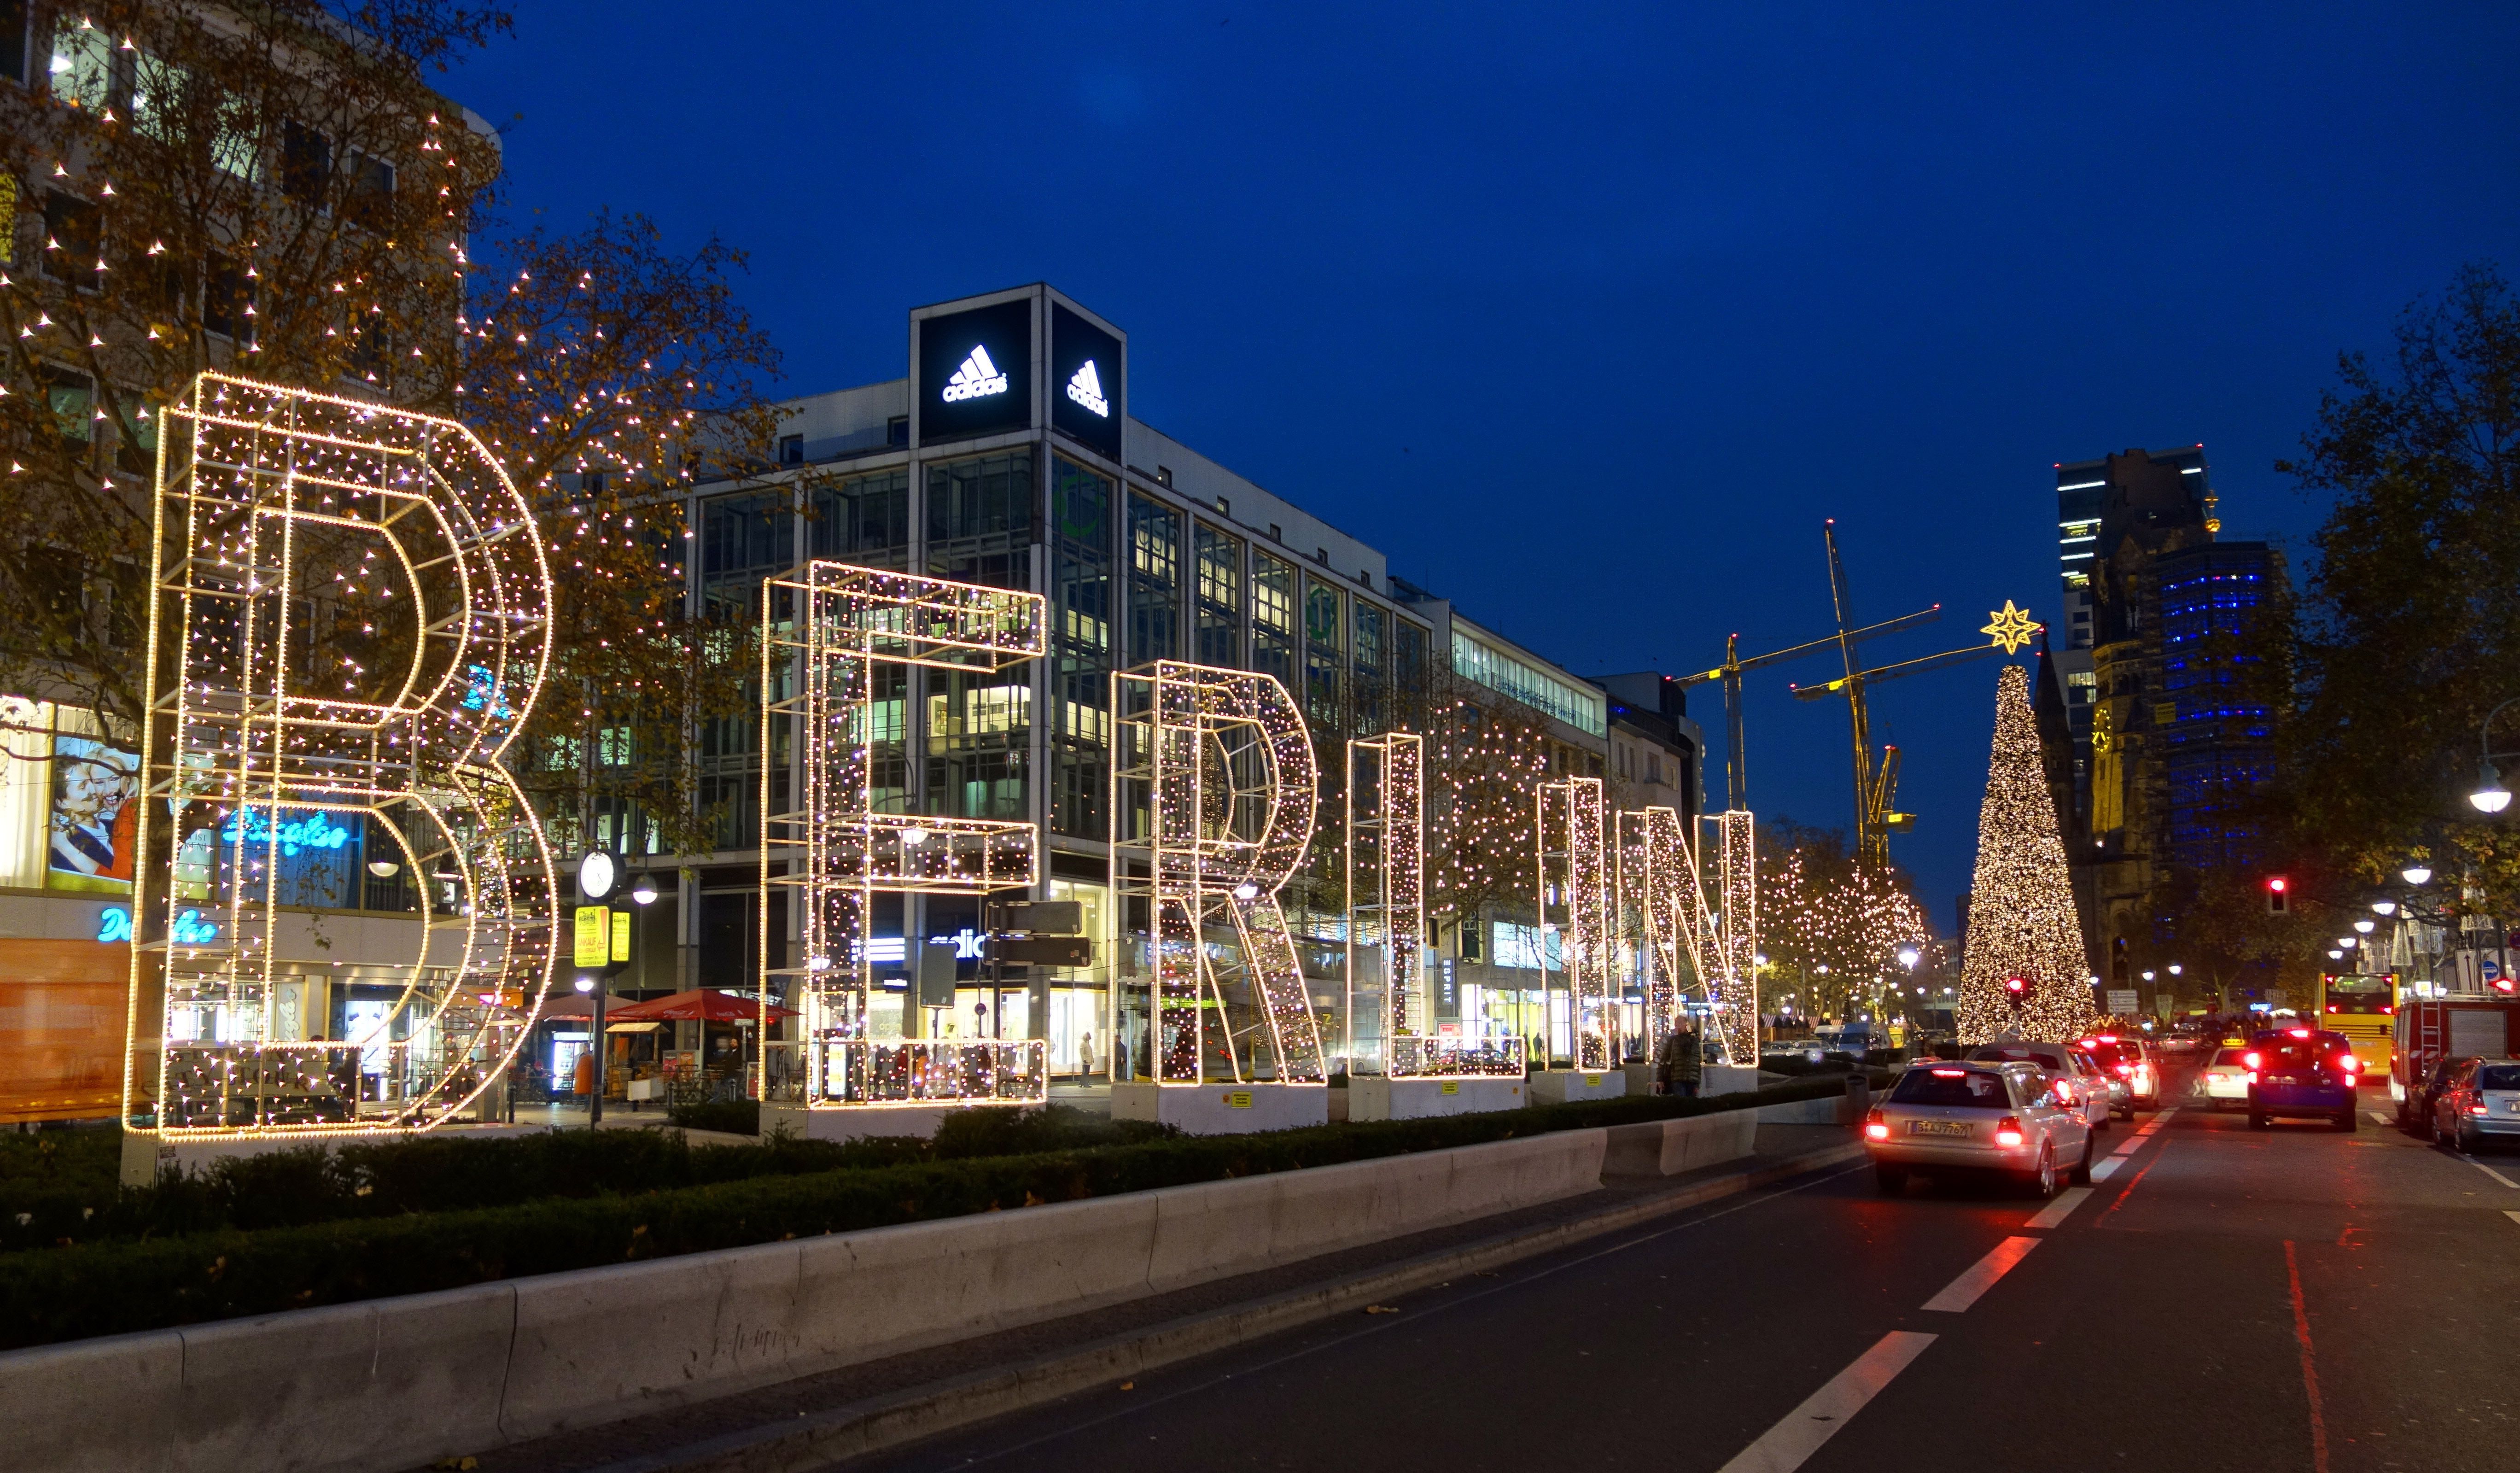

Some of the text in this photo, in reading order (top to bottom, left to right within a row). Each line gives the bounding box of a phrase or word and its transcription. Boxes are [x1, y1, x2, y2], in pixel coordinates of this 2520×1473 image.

[942, 374, 1008, 403] adidas
[1067, 381, 1108, 418] adidas
[98, 907, 216, 943] Dolas
[577, 937, 596, 947] ANKAUF
